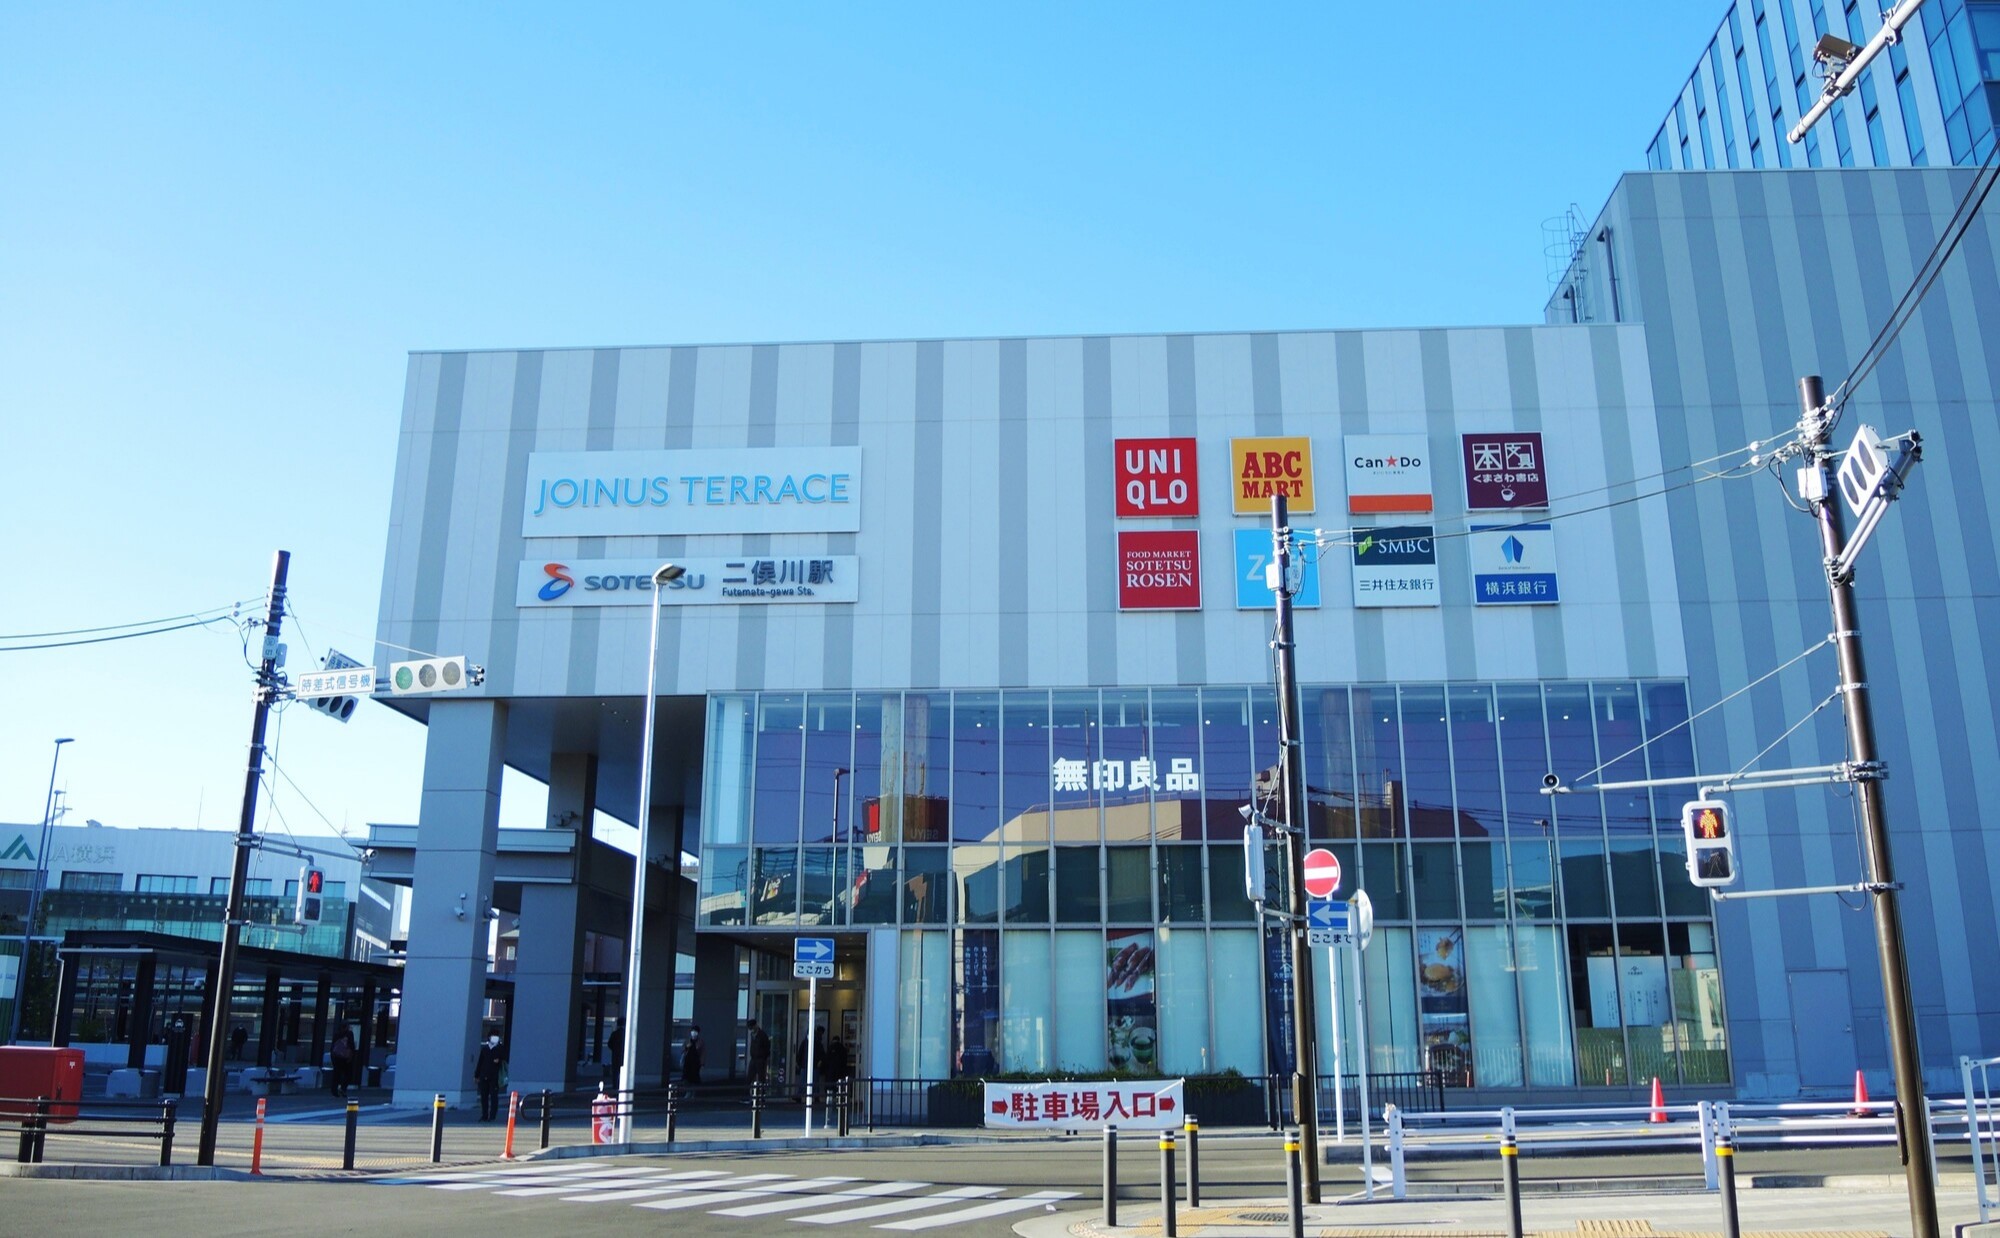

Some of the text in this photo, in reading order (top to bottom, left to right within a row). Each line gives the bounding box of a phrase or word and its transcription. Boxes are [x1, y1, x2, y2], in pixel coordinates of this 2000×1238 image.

[1125, 448, 1181, 475] UNI
[1241, 450, 1303, 479] ABC
[1472, 442, 1503, 471] 本
[1473, 472, 1539, 484] くまざわ書店
[533, 473, 850, 517] JOINUS TERRACE
[1126, 478, 1188, 510] QLO
[1242, 479, 1304, 499] MART
[1126, 550, 1192, 559] FOOD MARKET
[1378, 536, 1431, 554] SMBC
[722, 559, 834, 585] 二俣川駅
[1126, 559, 1192, 571] SOTETSU
[584, 573, 705, 591] SOTESU
[1126, 572, 1192, 588] ROSEN
[1359, 578, 1434, 591] 三井住友銀行
[1485, 579, 1548, 596] 横浜銀行
[722, 585, 815, 598] Futamata-gawa Sta.
[301, 673, 371, 693] 時差式信号機
[1052, 755, 1200, 792] 無印良品
[797, 965, 831, 975] ここから
[1010, 1091, 1157, 1122] 駐車場入口
